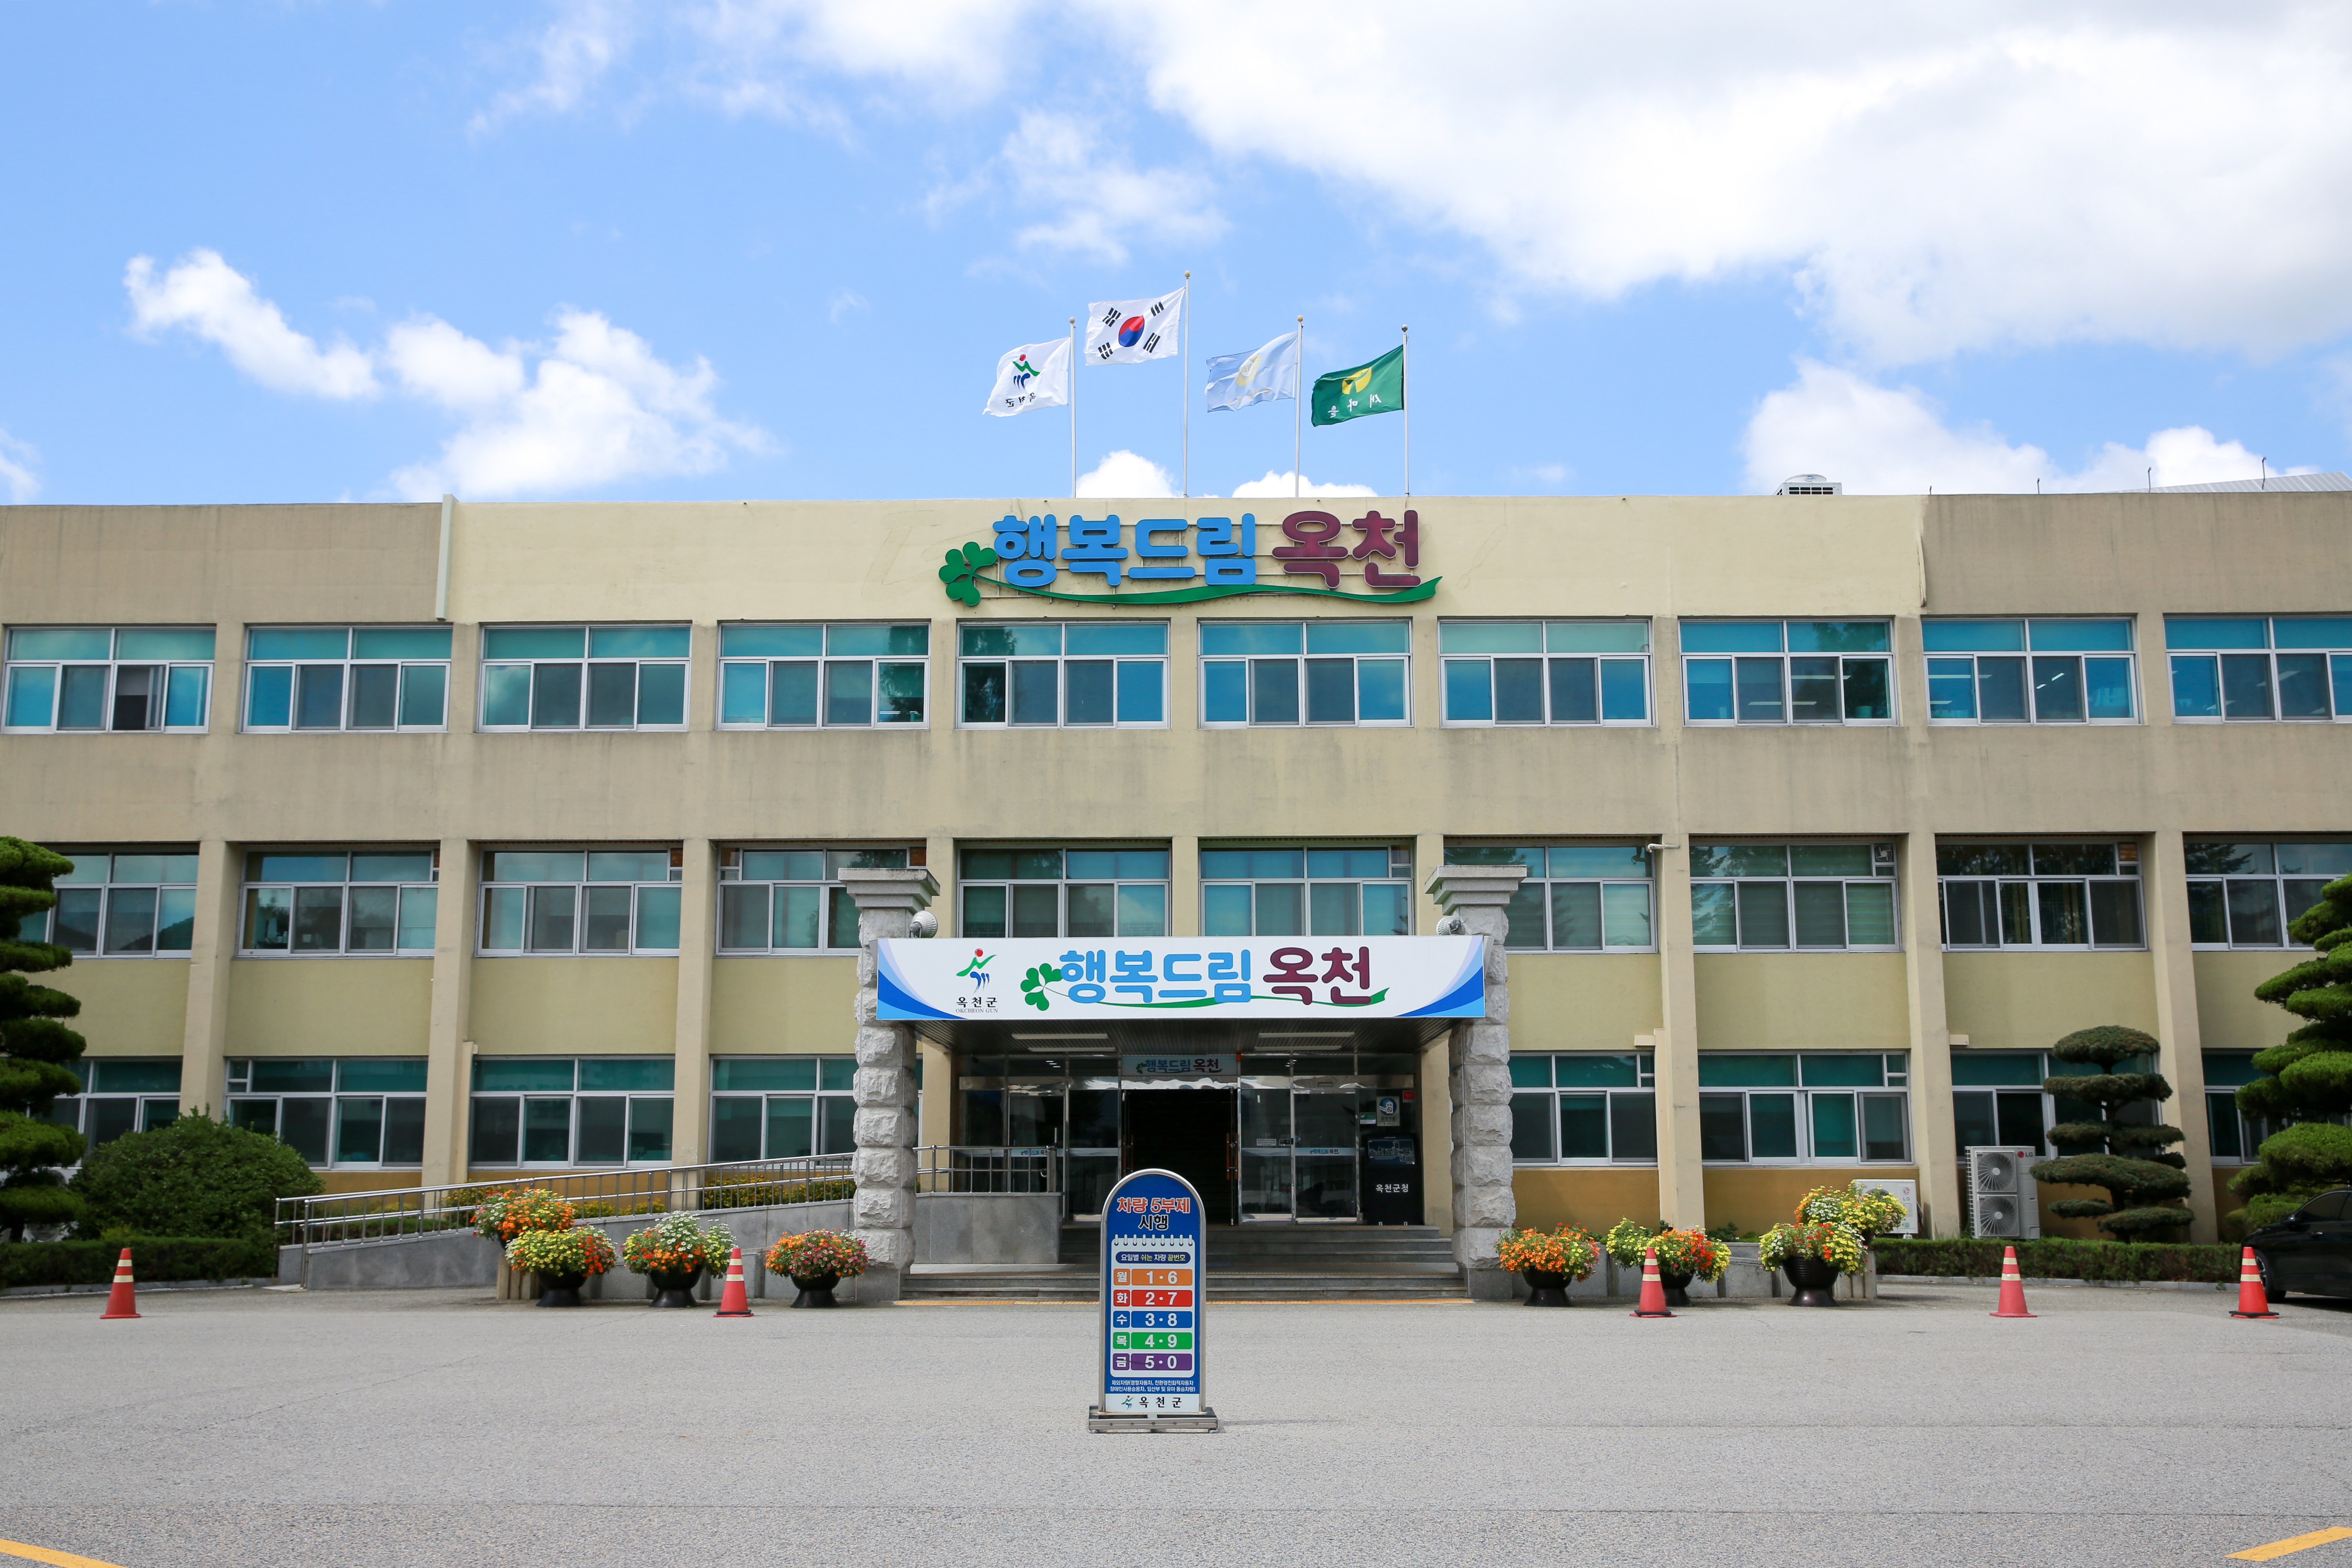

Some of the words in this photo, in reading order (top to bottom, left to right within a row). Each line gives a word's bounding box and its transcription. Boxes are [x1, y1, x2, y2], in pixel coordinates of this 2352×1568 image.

[993, 513, 1257, 587] 행복드림
[1272, 510, 1421, 588] 옥천
[1060, 949, 1251, 1004] 행복드림
[1263, 947, 1371, 1005] 옥천
[956, 997, 998, 1008] 옥천군
[1145, 1059, 1191, 1073] 행복드림
[1193, 1058, 1219, 1073] 옥천
[1376, 1184, 1409, 1193] 옥천군청
[1117, 1197, 1148, 1213] 차량
[1150, 1197, 1190, 1214] 5부제
[1138, 1214, 1169, 1231] 시행
[1117, 1272, 1127, 1283] 월
[1116, 1292, 1128, 1304] 화
[1116, 1314, 1127, 1325] 수
[1116, 1335, 1127, 1346] 목
[1116, 1356, 1127, 1368] 금
[1139, 1396, 1182, 1408] 옥천군
